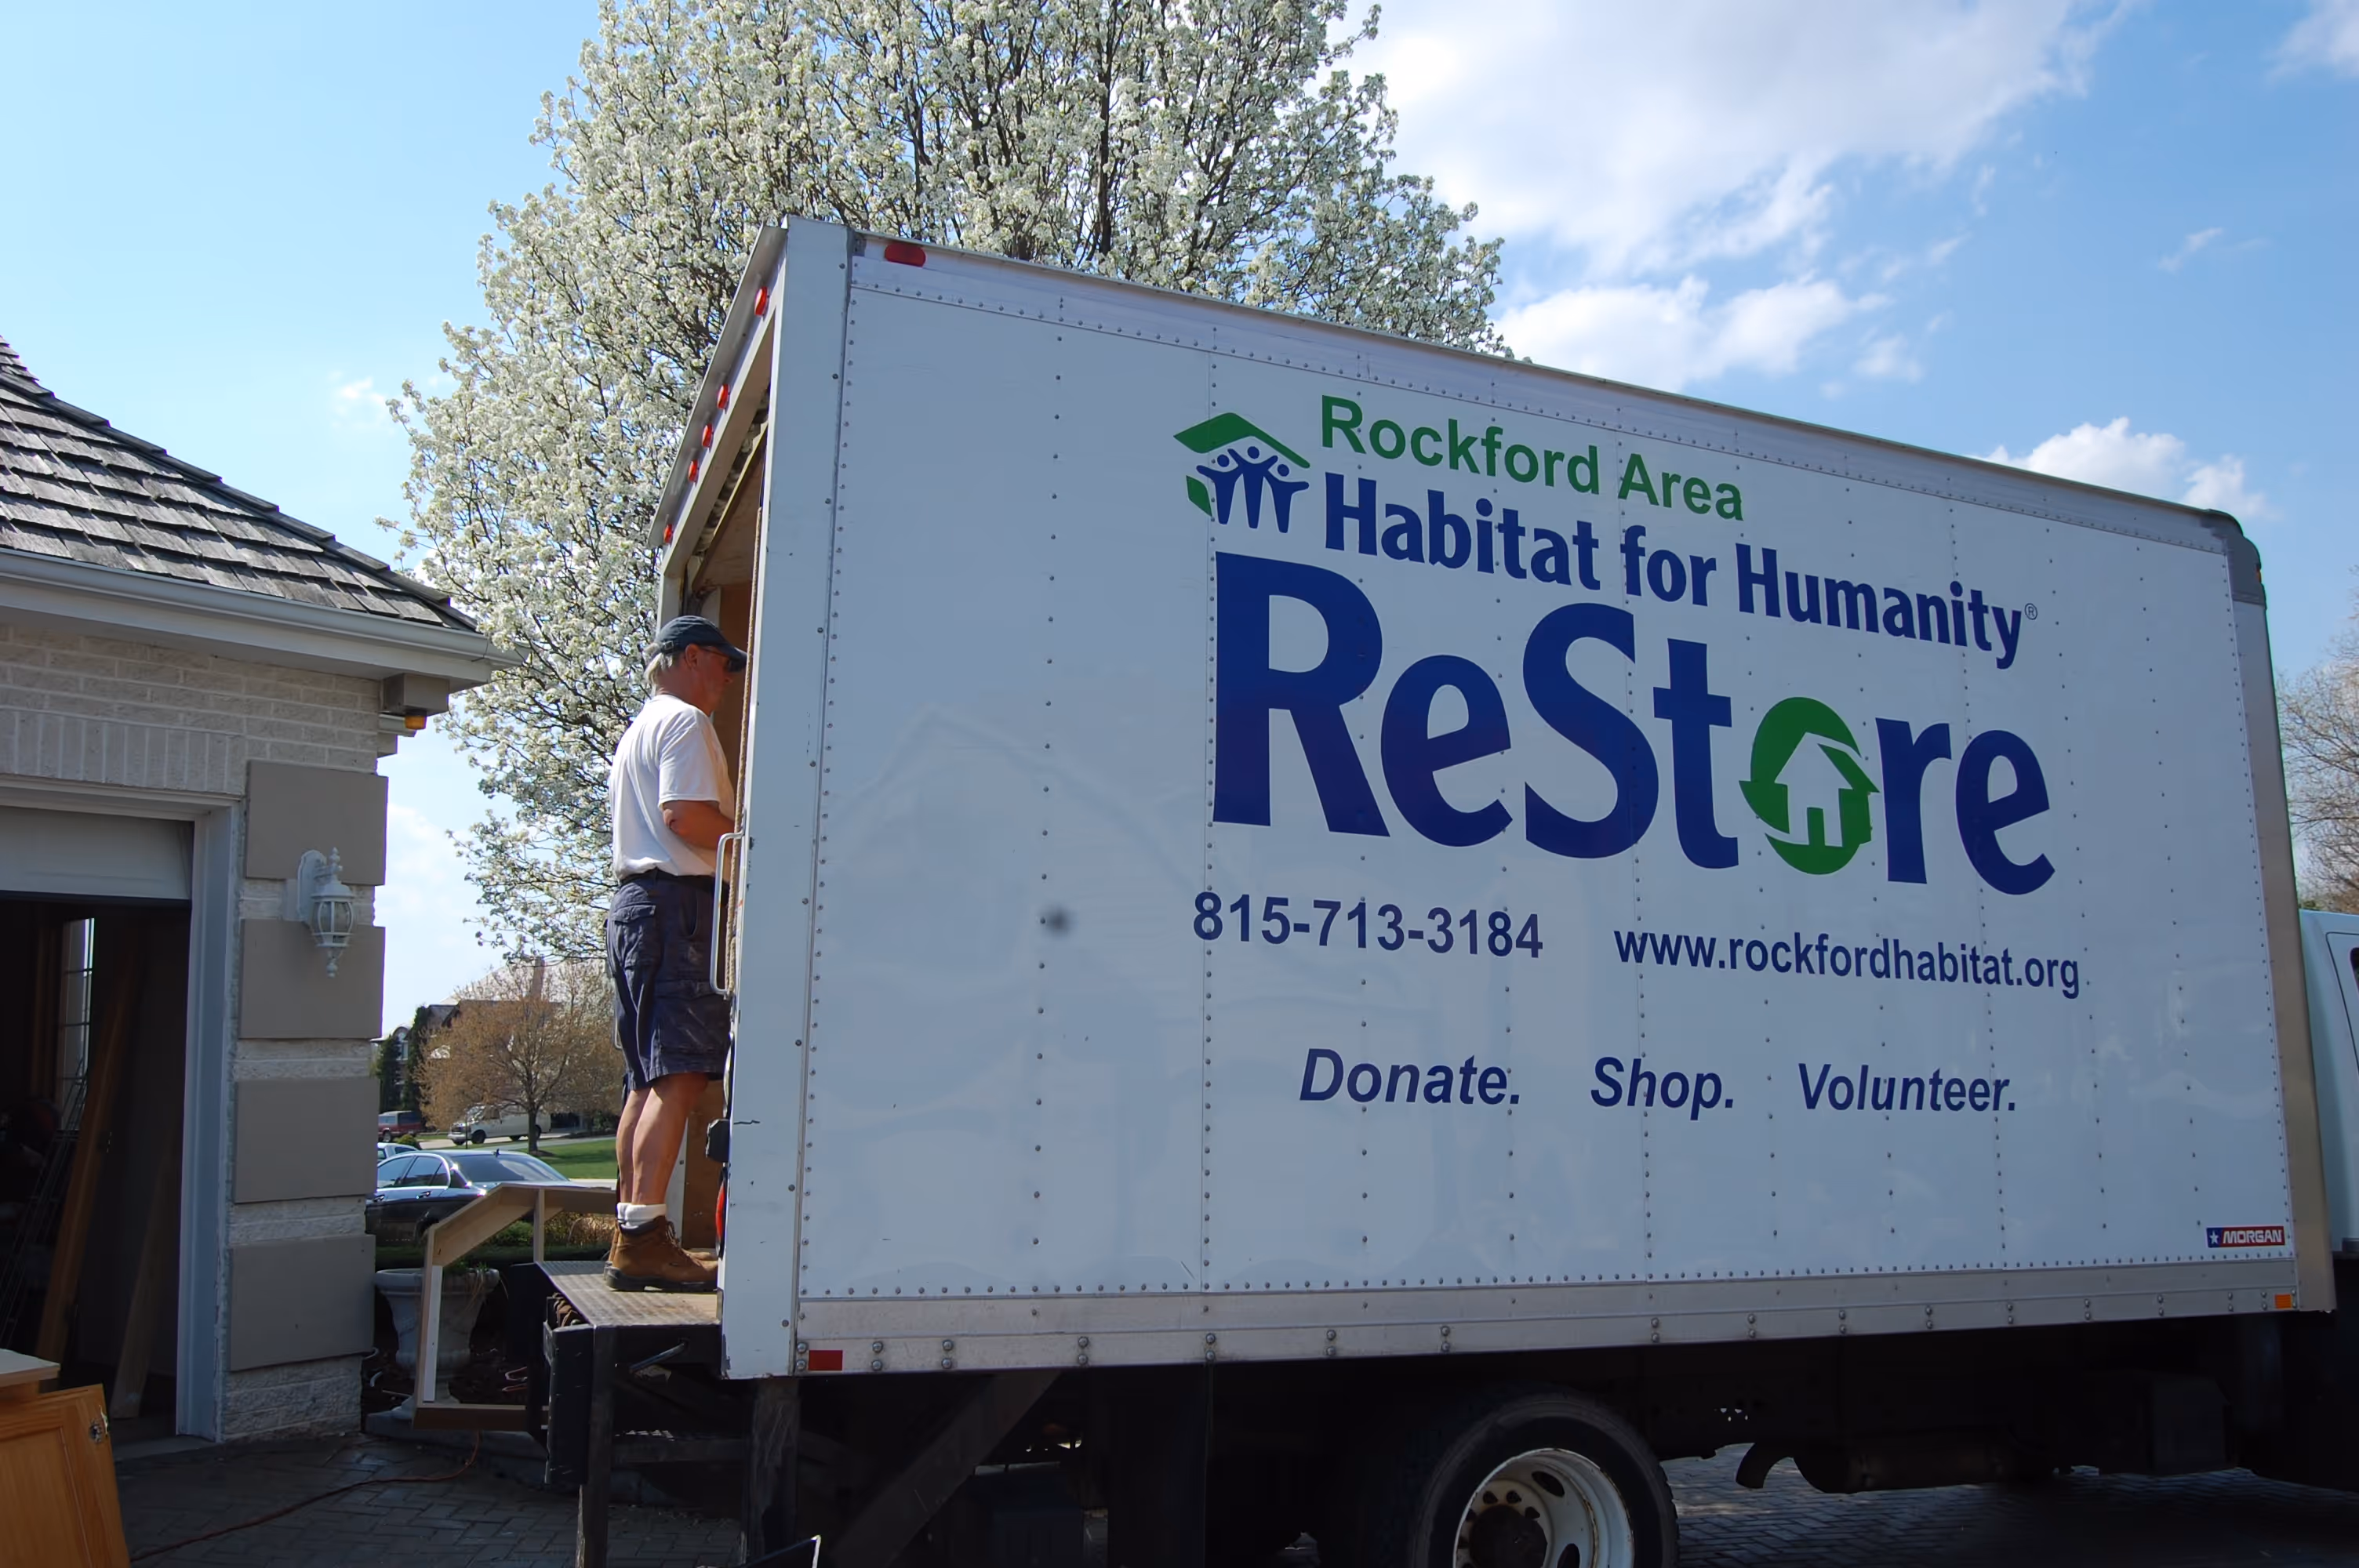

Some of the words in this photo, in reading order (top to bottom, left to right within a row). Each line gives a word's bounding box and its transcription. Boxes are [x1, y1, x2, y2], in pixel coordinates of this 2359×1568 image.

[1321, 394, 1600, 495] Rockford
[1617, 453, 1744, 521] Area
[1325, 471, 1601, 591] Habitat
[1619, 524, 1717, 607] for
[1193, 891, 1543, 958] 815-713-3184
[1613, 930, 2080, 1000] www.rockfordhabitat.org
[1299, 1048, 1521, 1106] Donate.
[1590, 1056, 1735, 1121] Shop.
[1798, 1062, 2016, 1112] Volunteer.
[2223, 1229, 2283, 1244] MORGAN
